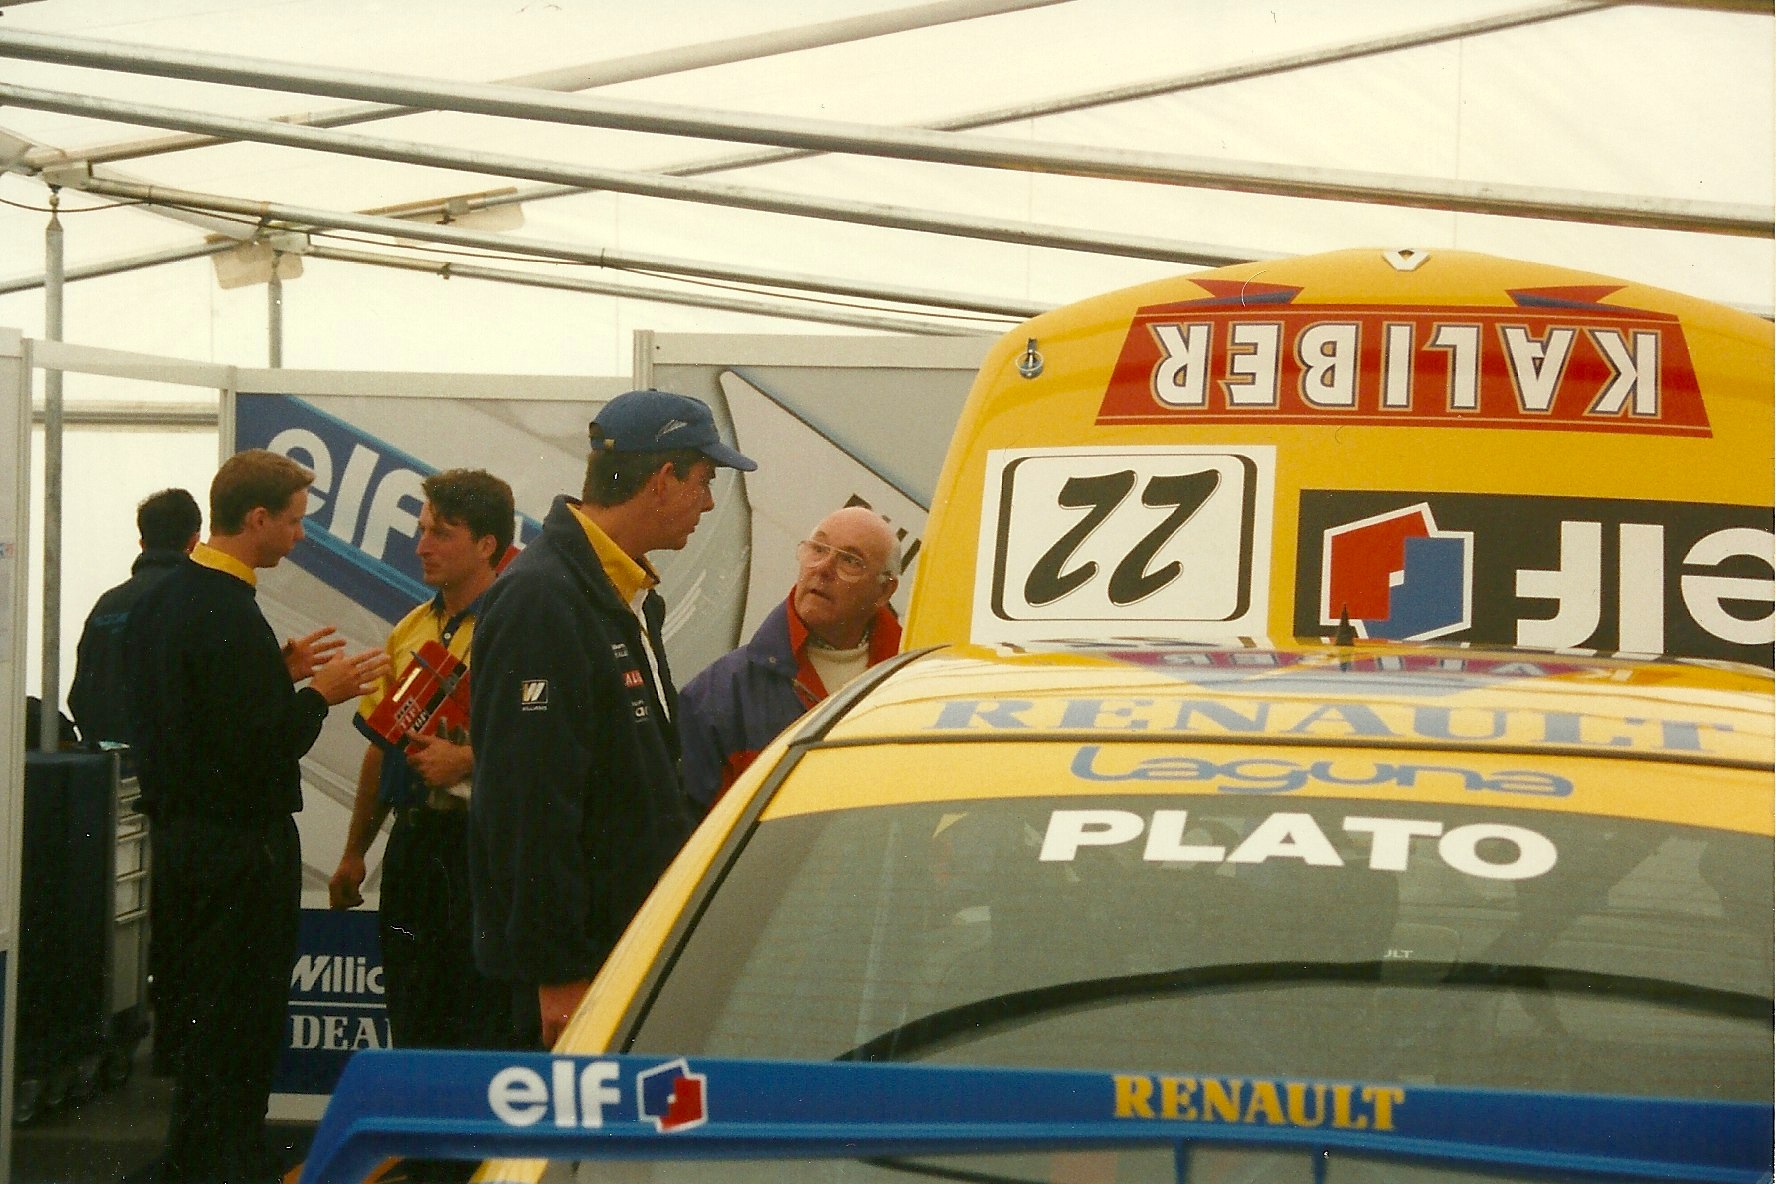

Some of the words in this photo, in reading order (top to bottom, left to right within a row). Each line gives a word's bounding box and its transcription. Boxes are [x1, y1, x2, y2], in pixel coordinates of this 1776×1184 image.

[1151, 318, 1664, 420] KALIBER
[1025, 468, 1223, 608] 22
[1515, 520, 1775, 654] elf
[922, 696, 1736, 754] RENAULT
[1039, 809, 1558, 881] PLATO
[488, 1059, 621, 1129] elf
[1113, 1073, 1406, 1131] RENAULT
